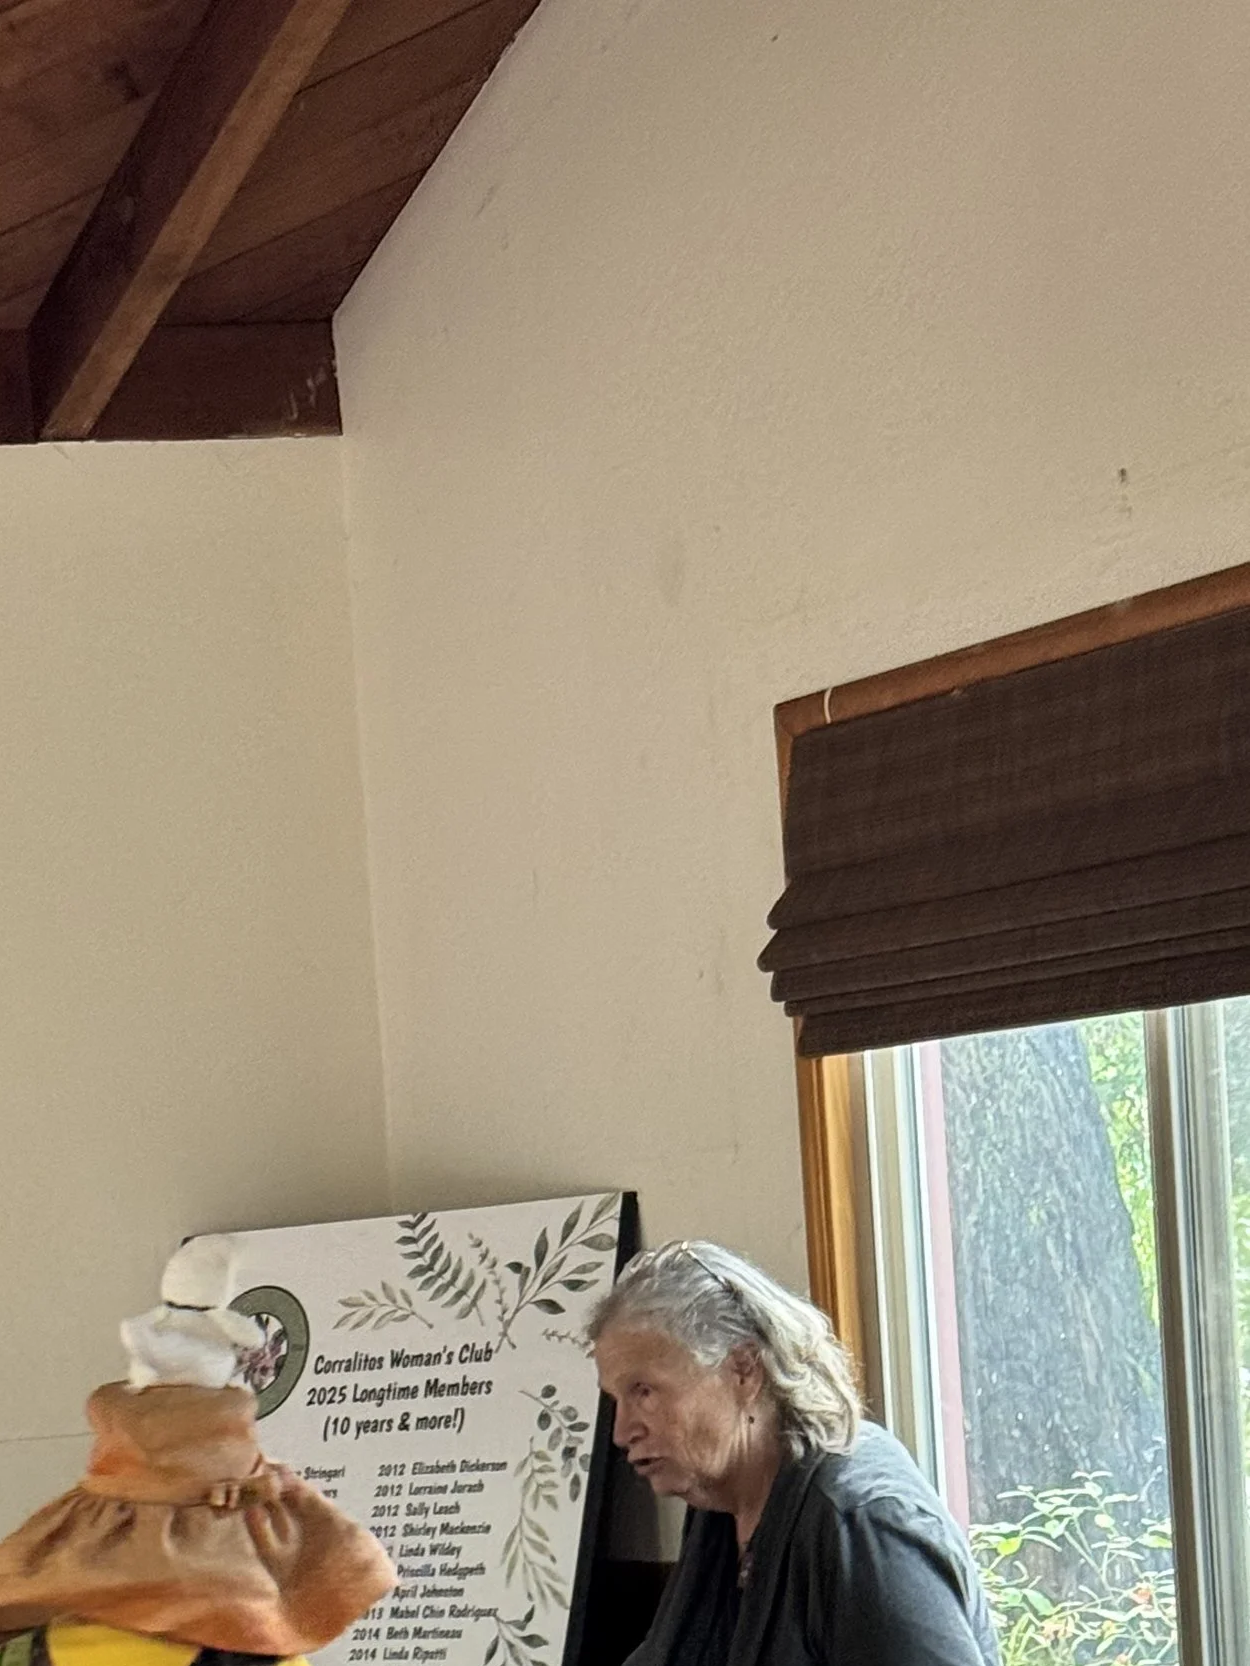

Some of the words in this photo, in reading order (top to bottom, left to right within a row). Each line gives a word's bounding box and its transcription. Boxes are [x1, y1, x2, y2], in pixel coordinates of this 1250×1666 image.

[314, 1351, 384, 1375] Corralitos
[390, 1346, 454, 1369] Woman's
[458, 1341, 493, 1364] Club
[306, 1385, 347, 1406] 2025
[352, 1381, 419, 1408] Longtime
[424, 1375, 493, 1398] Members
[324, 1415, 349, 1441] (10
[354, 1416, 393, 1440] years
[398, 1412, 410, 1431] &
[415, 1407, 465, 1434] more!)
[378, 1464, 405, 1477] 2012
[412, 1460, 456, 1475] Elizabeth
[459, 1459, 507, 1473] Dickerson
[374, 1484, 402, 1498] 2012
[409, 1482, 448, 1496] Lorraine
[371, 1504, 400, 1518] 2012
[405, 1502, 430, 1518] Sally
[433, 1501, 460, 1516] Leach
[402, 1522, 437, 1539] Shirley
[399, 1544, 425, 1557] Linda
[392, 1585, 418, 1602] April
[390, 1604, 420, 1619] Mabel
[352, 1628, 380, 1640] 2014
[386, 1626, 409, 1640] Beth
[349, 1648, 377, 1661] 2014
[383, 1646, 409, 1660] Linda
